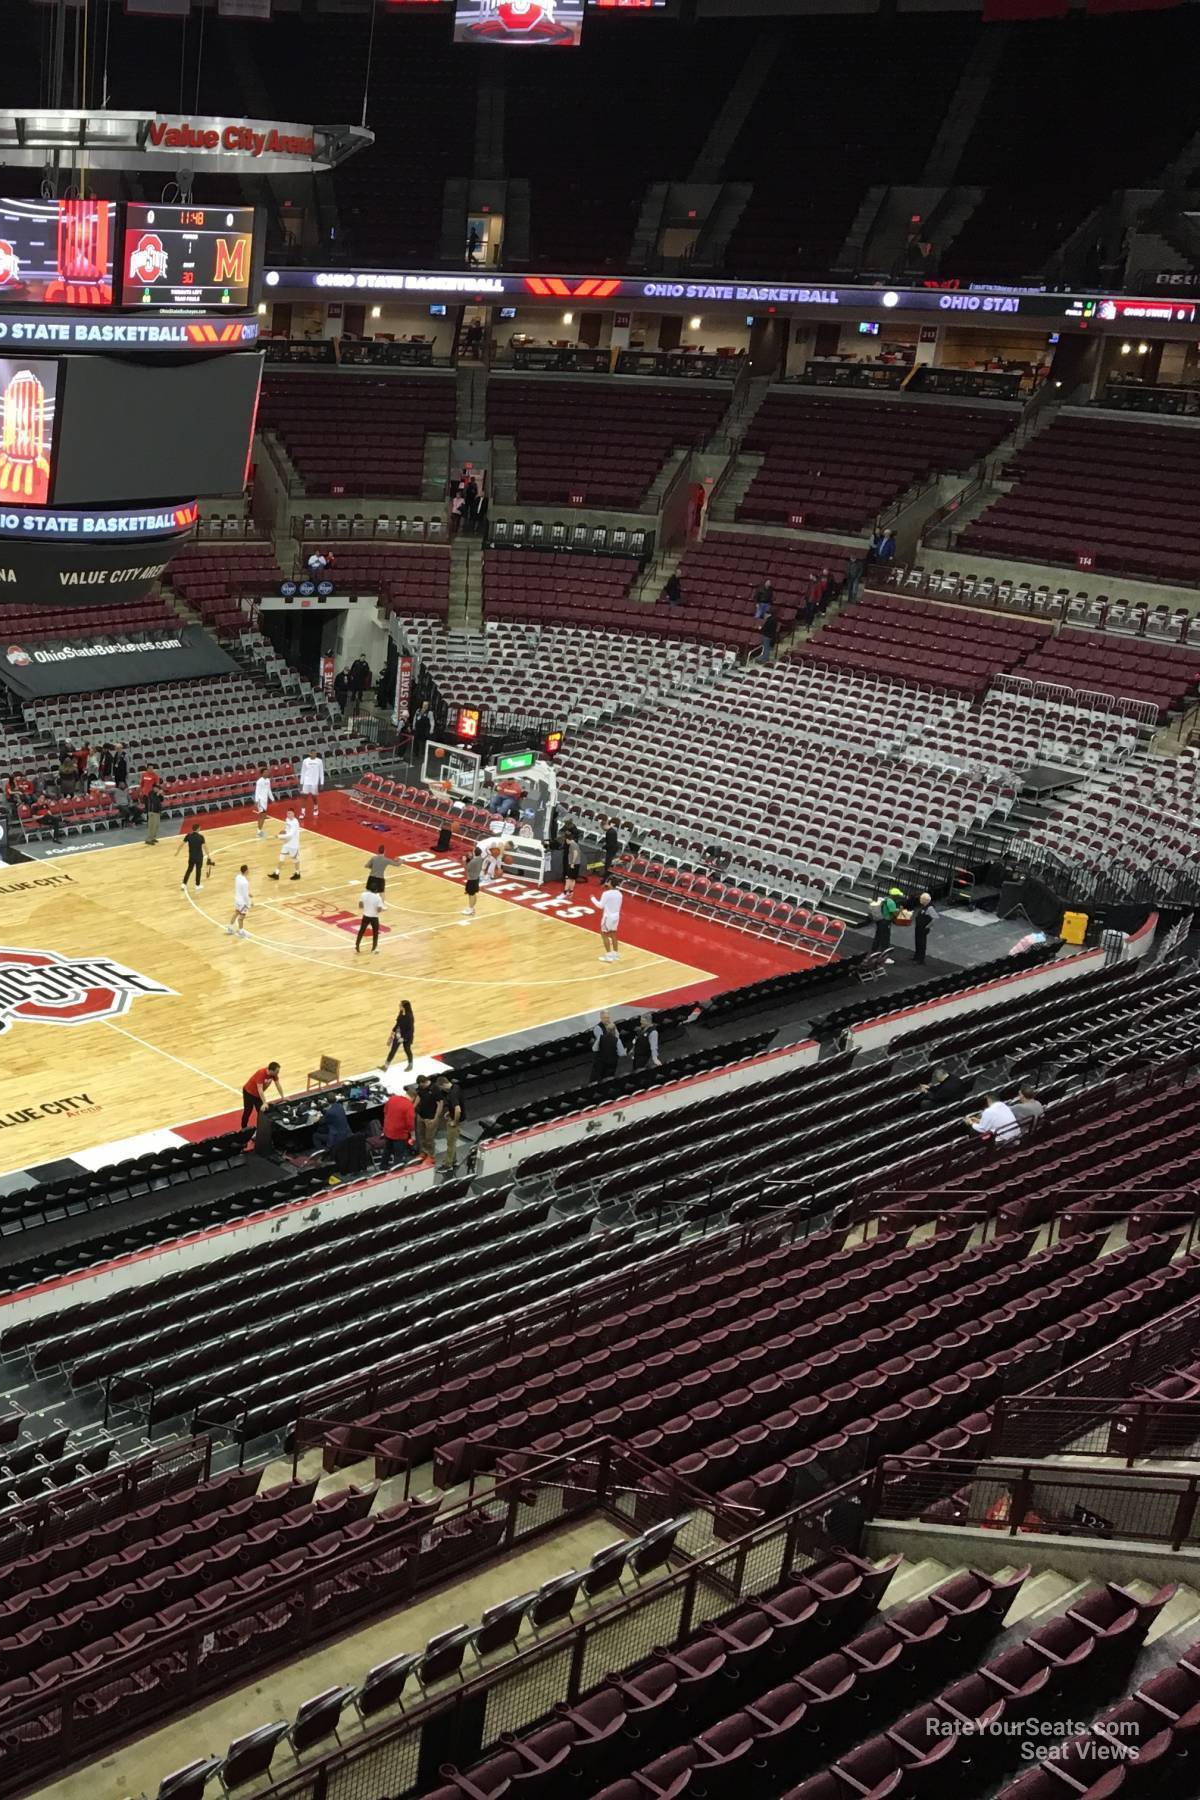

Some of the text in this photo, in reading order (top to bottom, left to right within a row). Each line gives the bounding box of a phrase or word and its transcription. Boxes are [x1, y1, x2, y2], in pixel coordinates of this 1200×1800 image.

[150, 122, 315, 157] Value City Arena
[315, 273, 504, 292] OHIO STATE BASKETBALL
[643, 284, 839, 304] OHIO STATE BASKETBALL
[939, 295, 979, 311] OHIO
[11, 323, 70, 341] STATE
[75, 324, 188, 342] BASKETBALL
[23, 516, 78, 533] STATE
[83, 513, 175, 532] BASKETBALL
[59, 570, 108, 586] VALUE
[110, 565, 144, 584] CITY
[33, 639, 181, 664] OhioStateBuckeyes.com
[401, 671, 411, 698] STATE
[34, 874, 74, 888] CITY
[399, 850, 596, 920] BUCEYES
[39, 1093, 96, 1115] CITY
[66, 1104, 103, 1118] Arena
